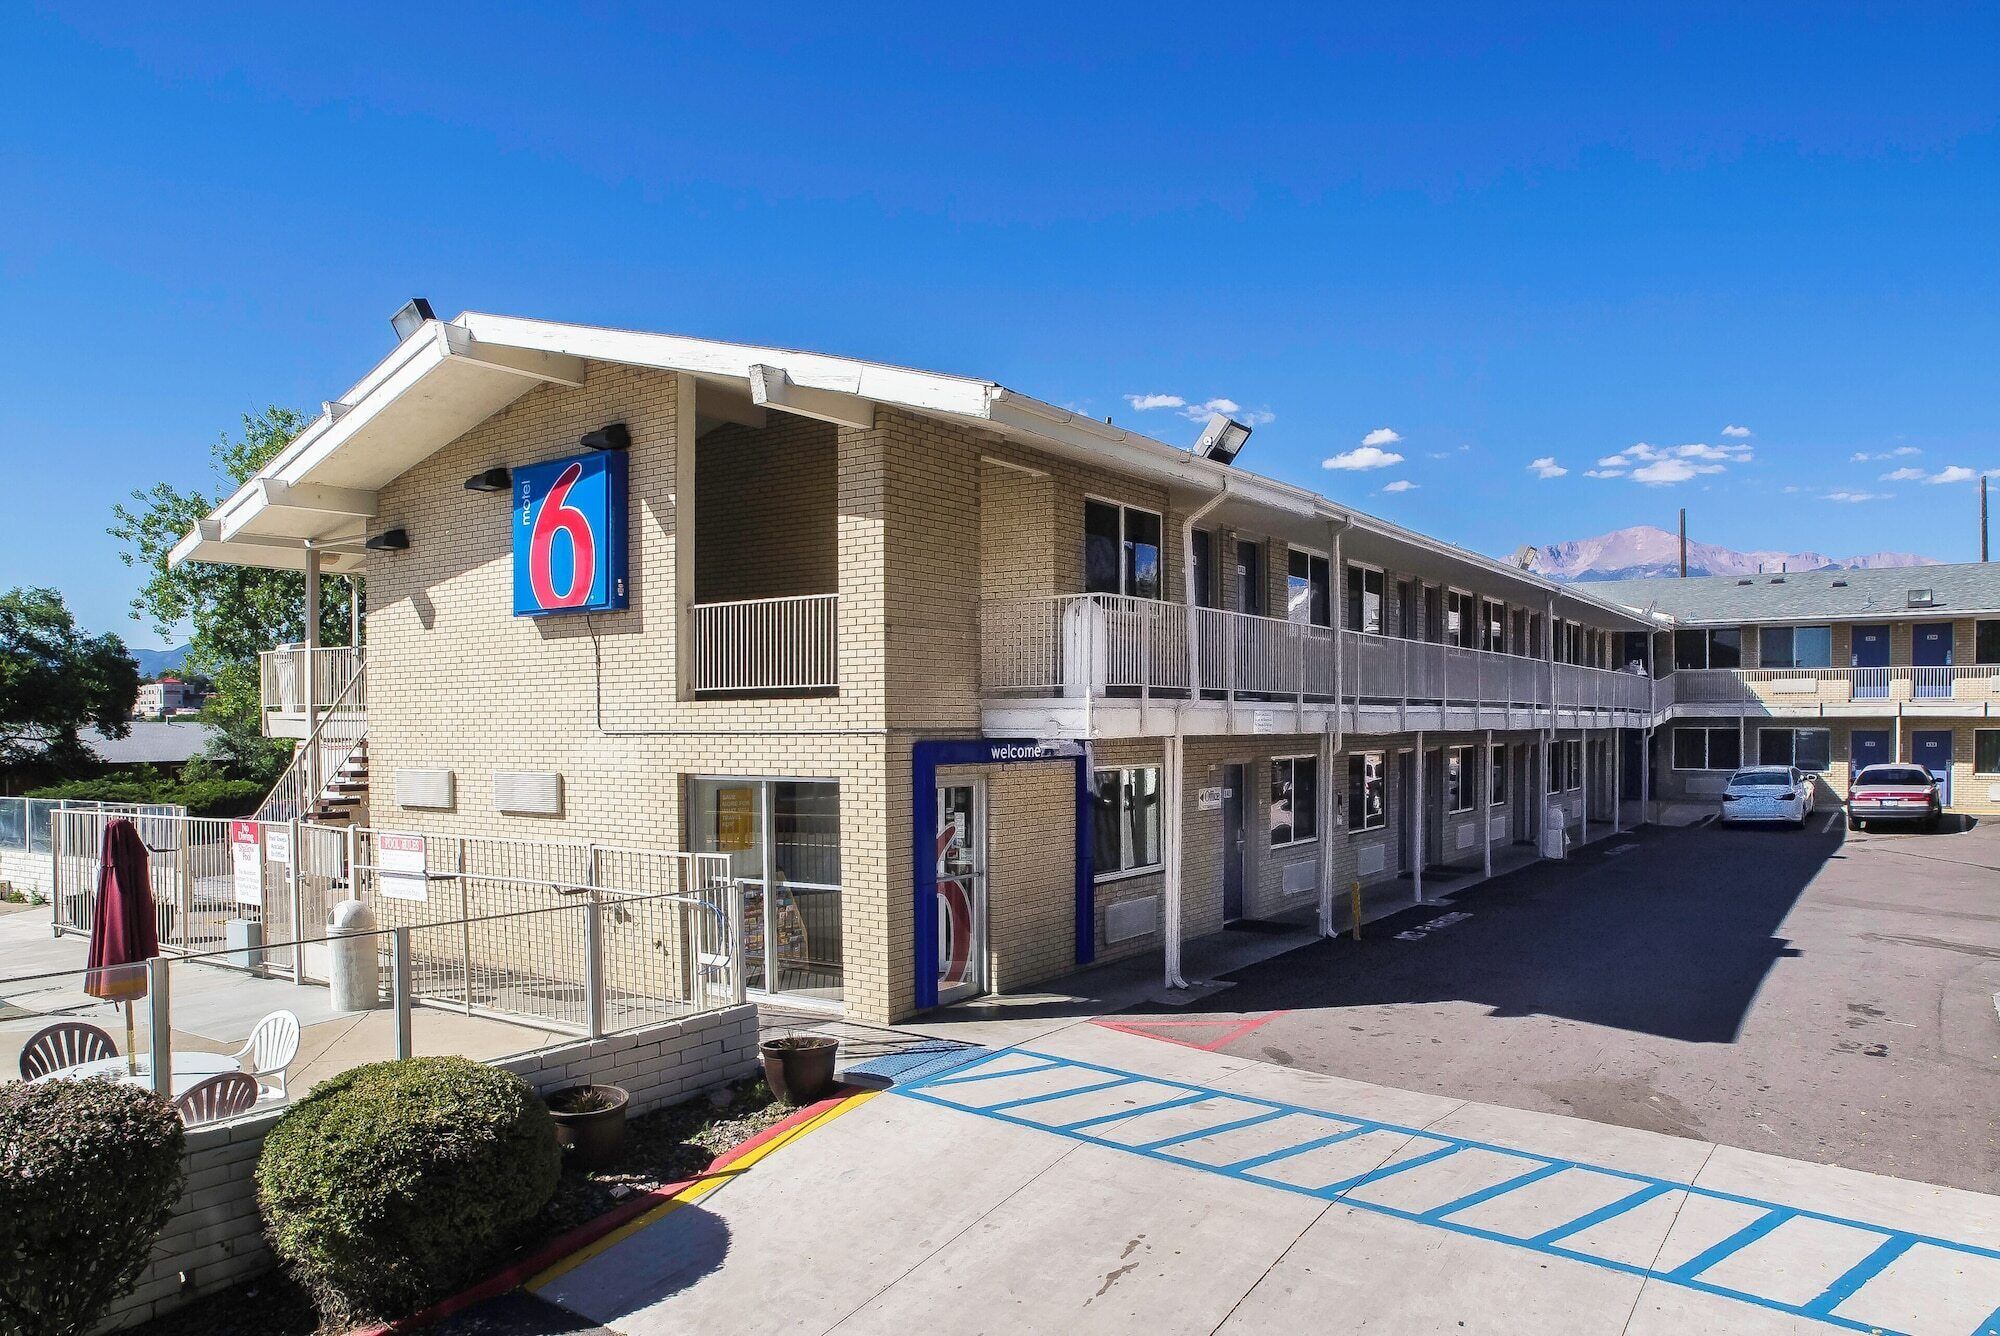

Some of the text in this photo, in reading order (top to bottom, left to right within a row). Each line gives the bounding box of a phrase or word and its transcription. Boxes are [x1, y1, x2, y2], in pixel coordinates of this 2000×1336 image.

[521, 480, 531, 526] motel
[529, 462, 596, 610] 6
[991, 743, 1041, 759] welcome
[241, 822, 250, 833] No
[237, 831, 254, 844] Diving
[384, 836, 419, 851] POOL RULES
[242, 852, 251, 861] Pool
